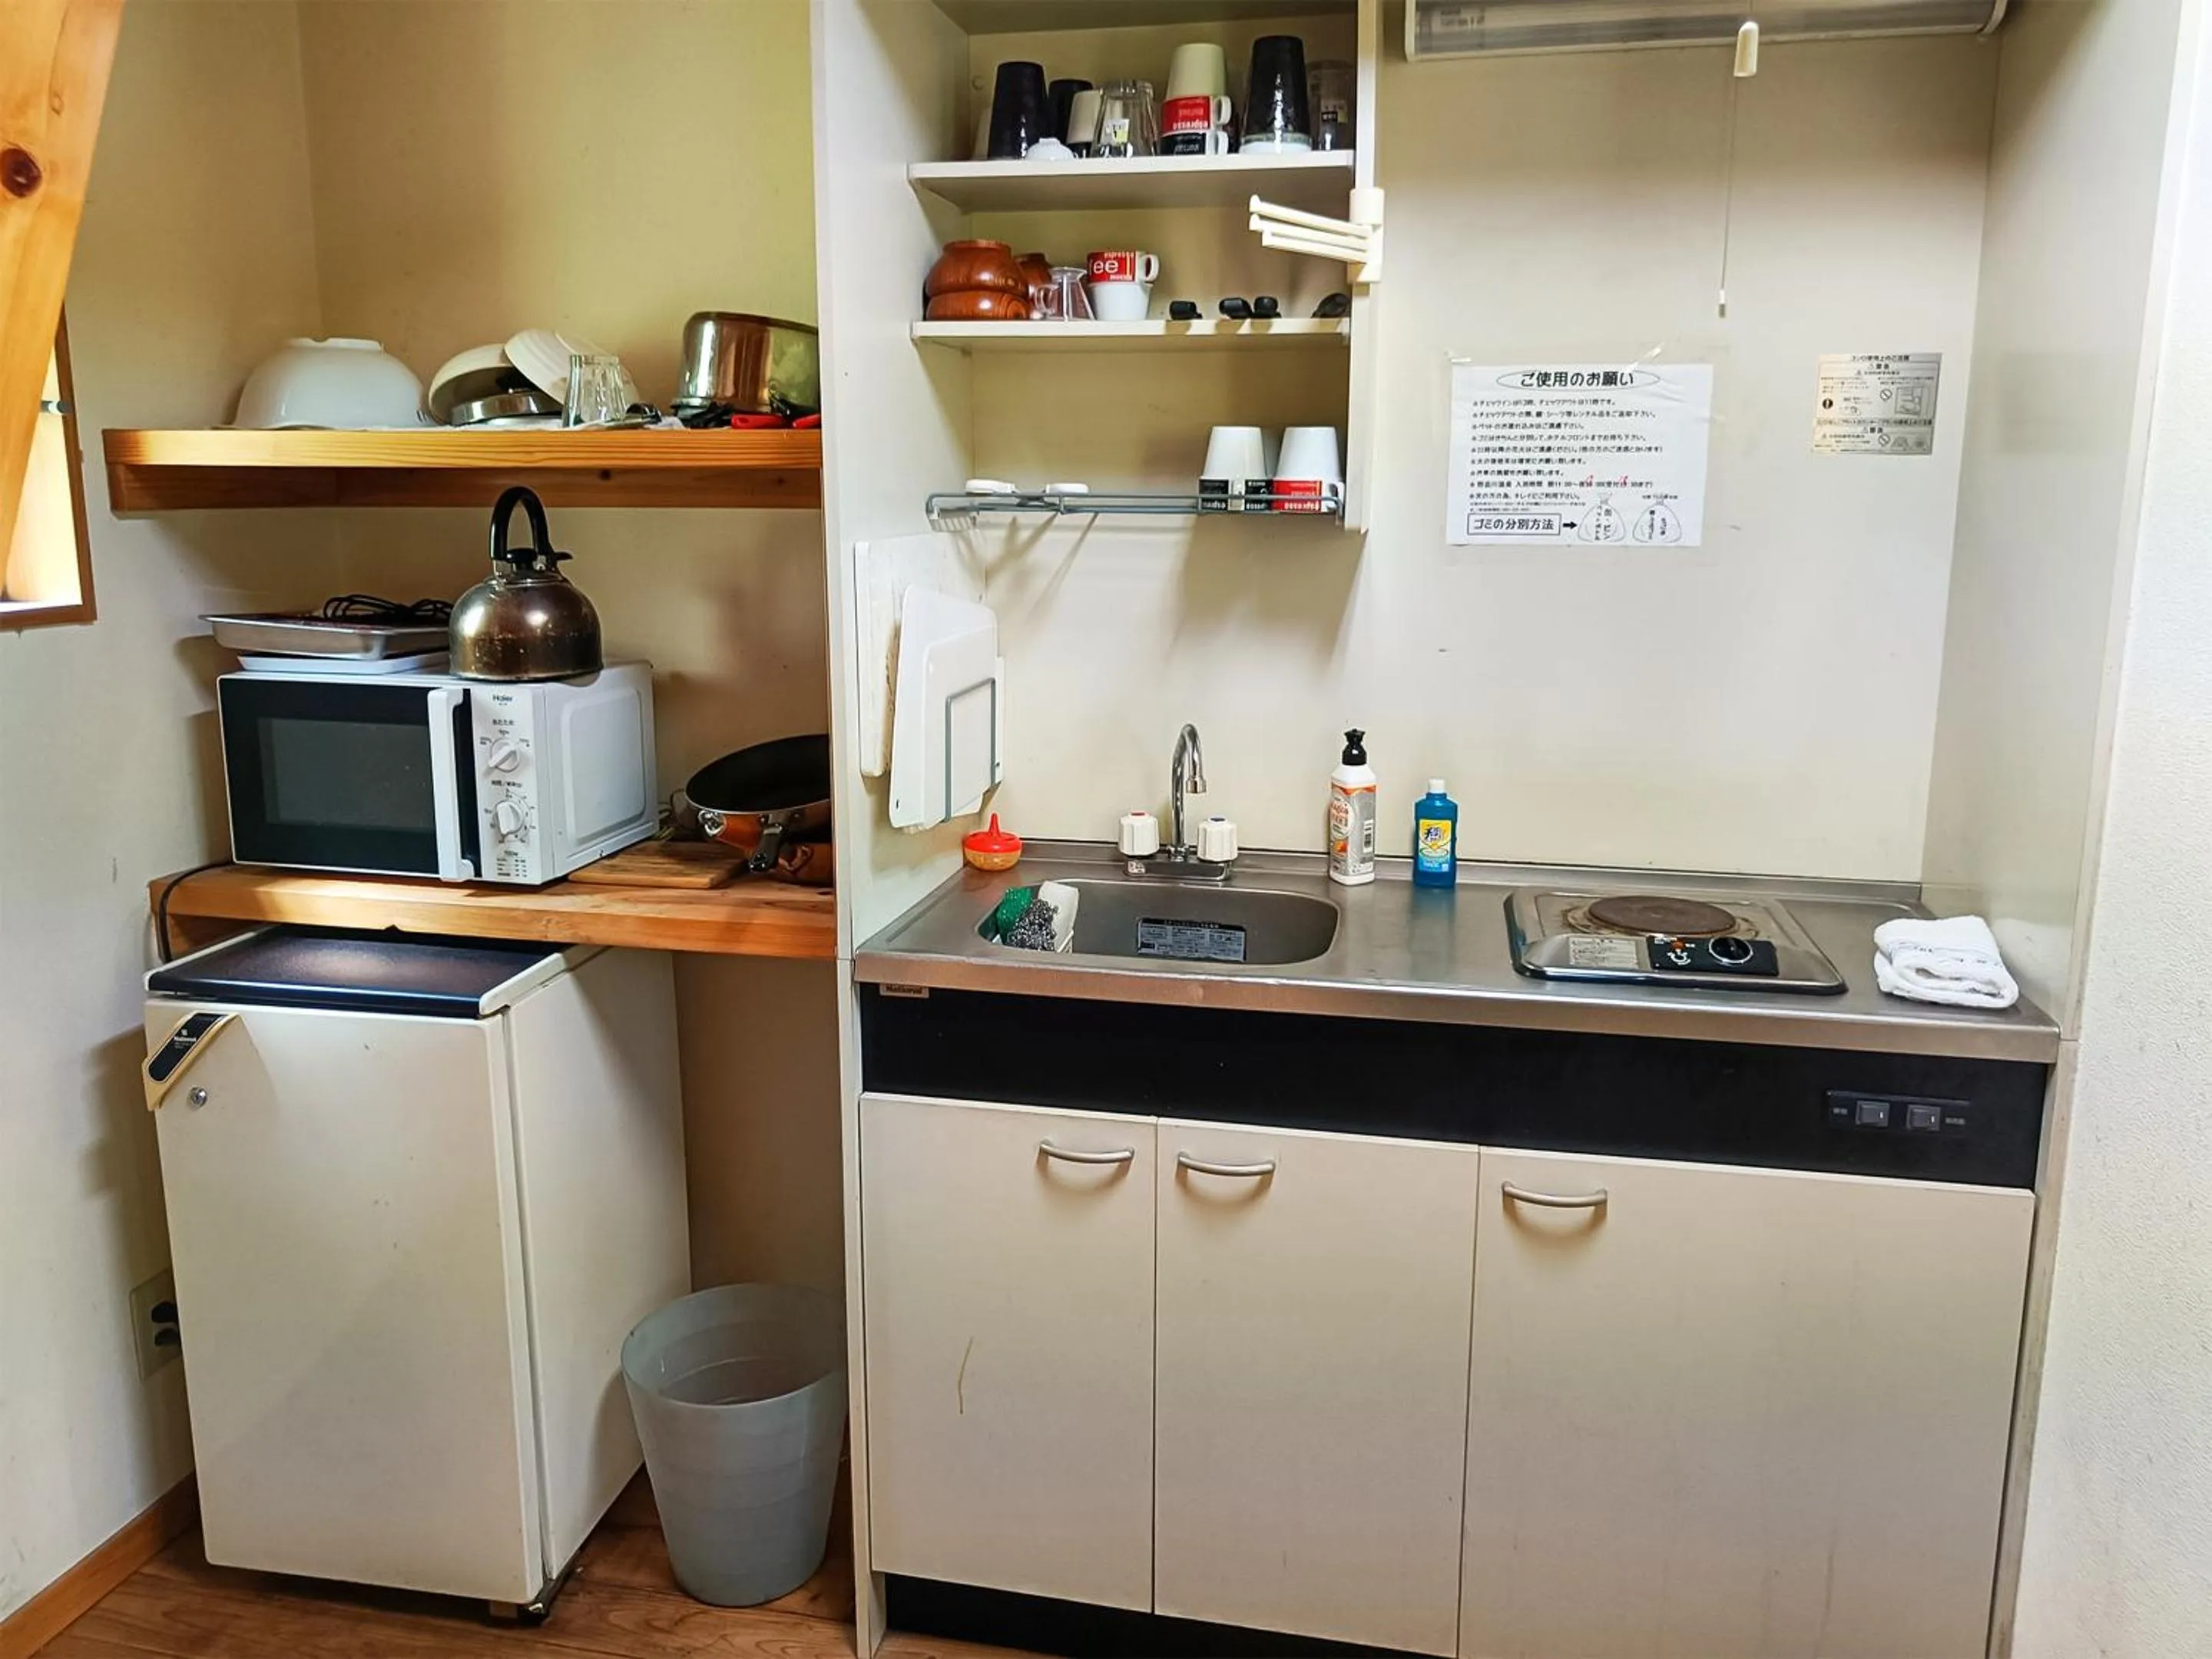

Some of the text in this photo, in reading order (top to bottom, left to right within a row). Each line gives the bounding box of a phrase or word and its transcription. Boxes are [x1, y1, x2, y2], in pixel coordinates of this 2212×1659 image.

[1520, 371, 1634, 388] ご使用のお願い
[1474, 518, 1555, 530] ゴミの分別方法
